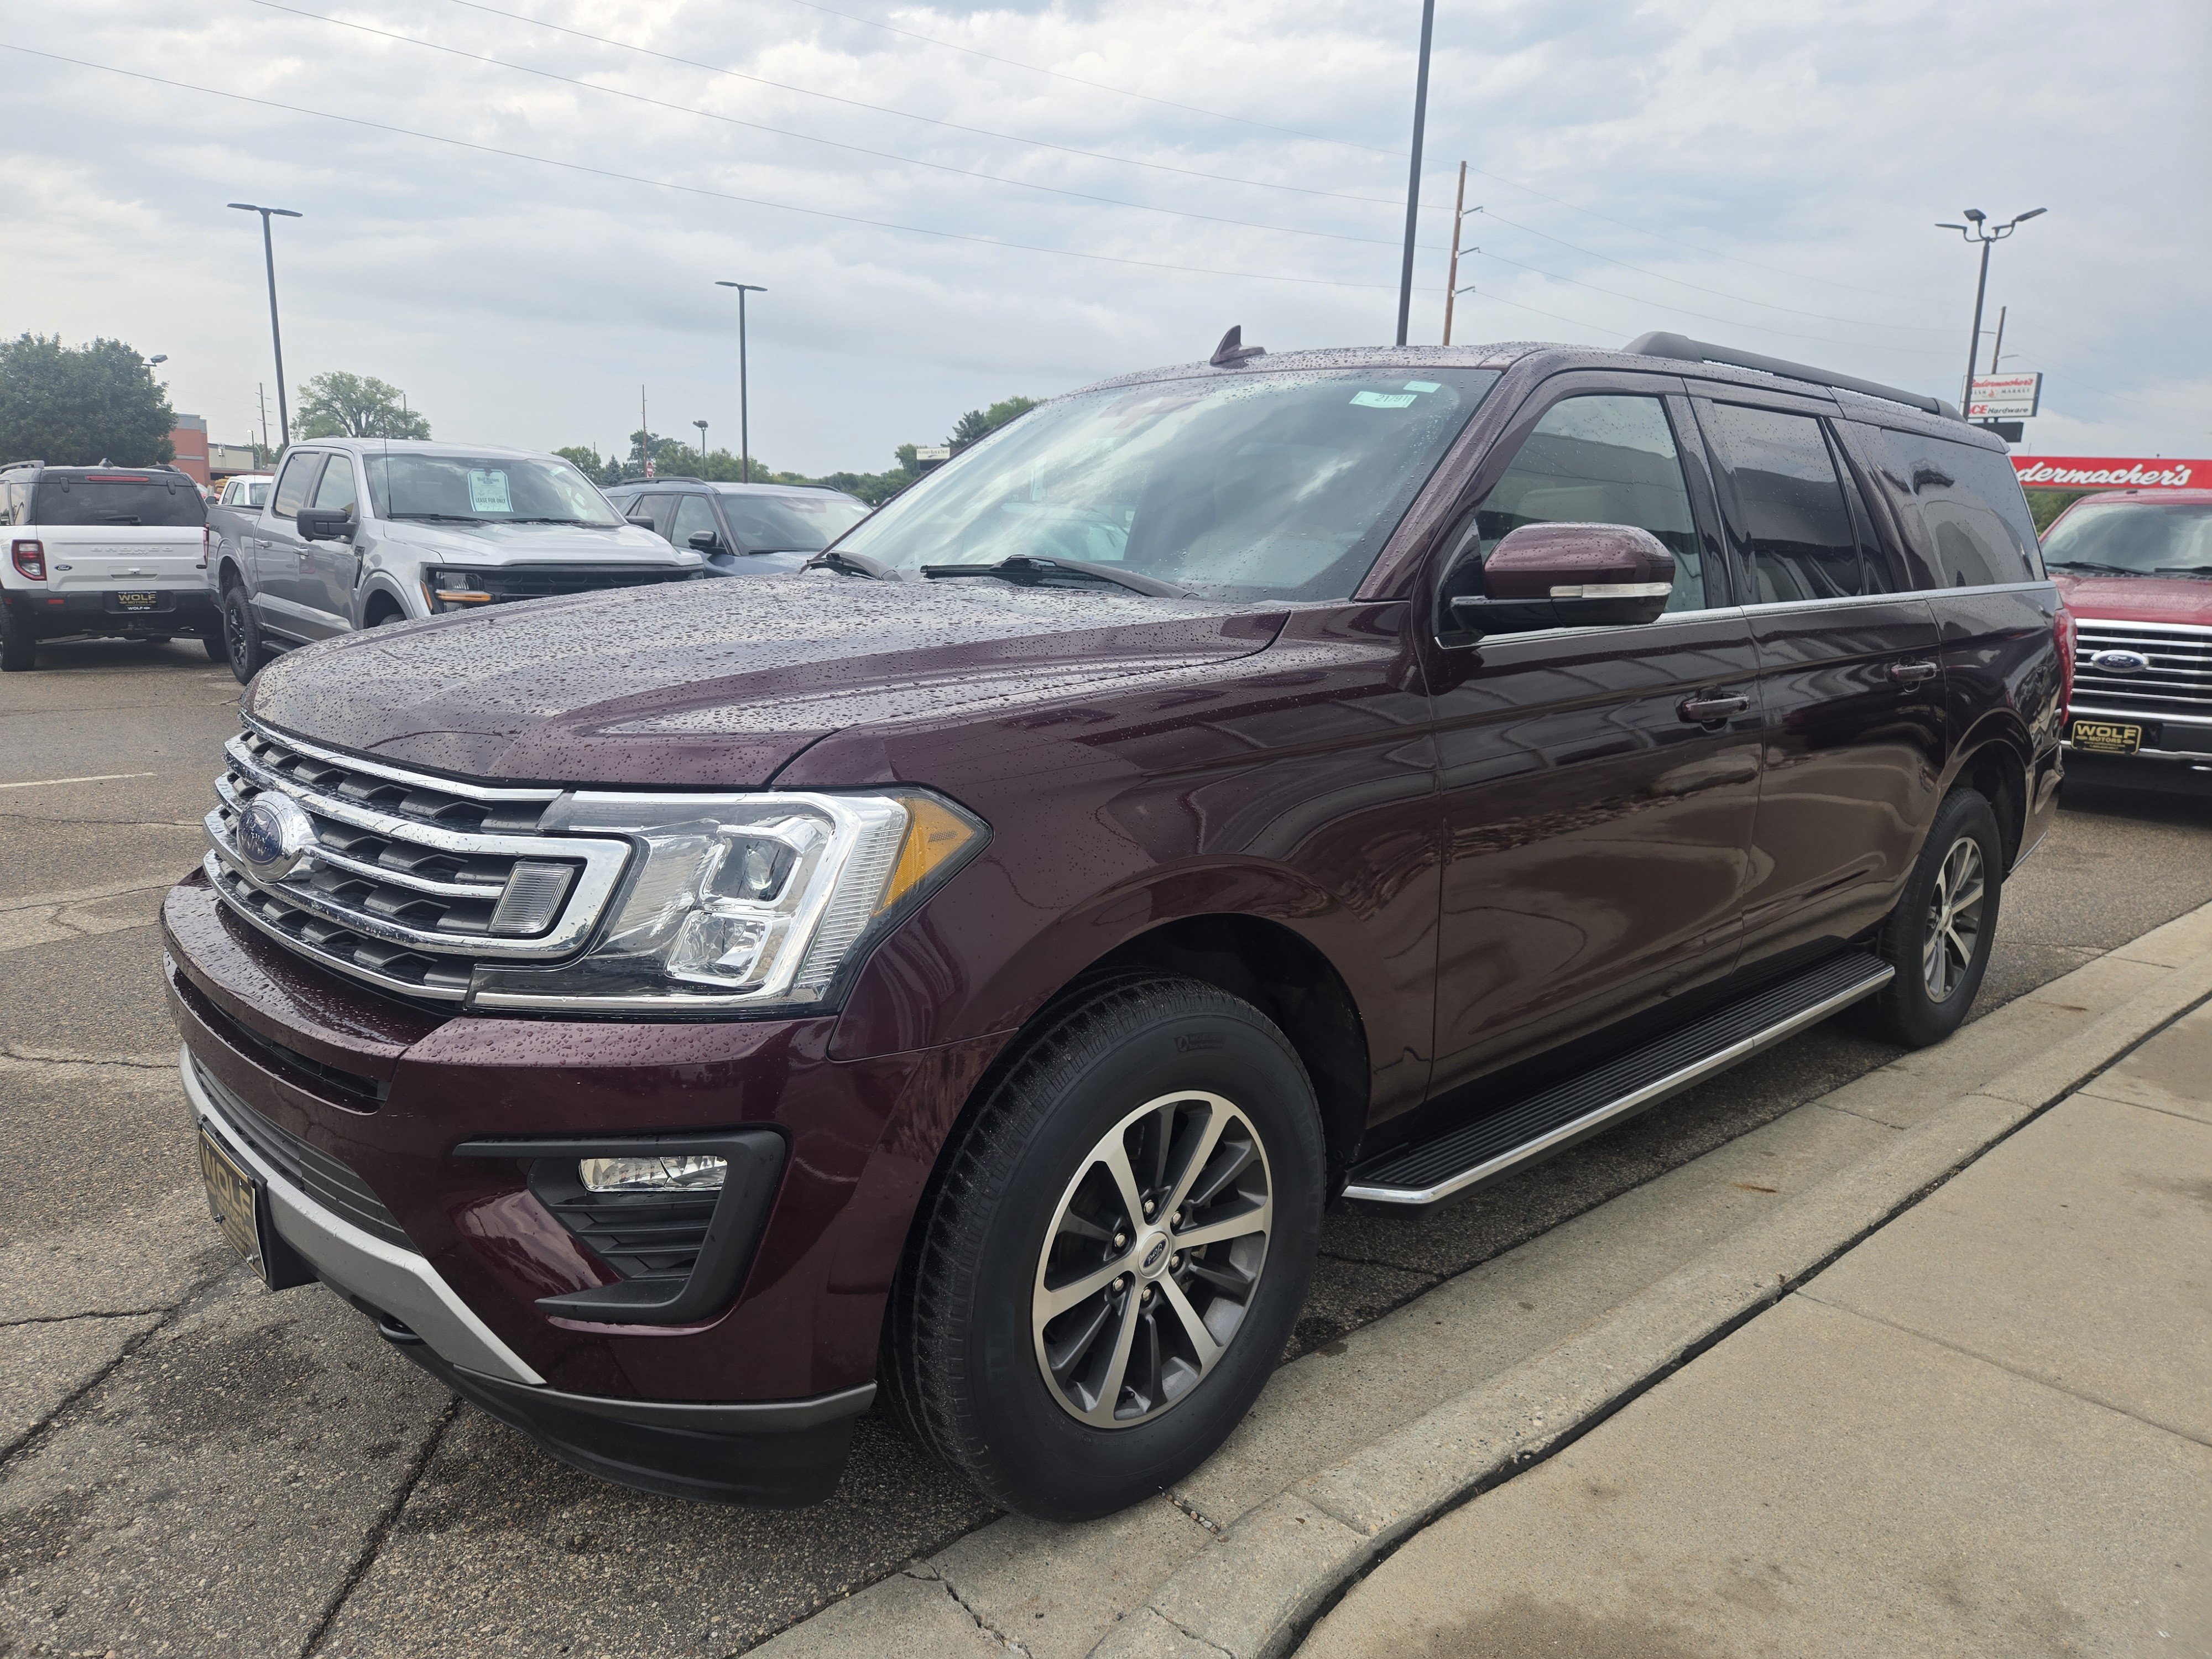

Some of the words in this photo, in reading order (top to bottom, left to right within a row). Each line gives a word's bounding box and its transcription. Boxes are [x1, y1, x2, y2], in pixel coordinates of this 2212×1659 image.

[1973, 378, 2034, 388] adermacher's
[1969, 405, 1988, 414] CE
[2016, 461, 2192, 486] dermacher's
[2077, 724, 2137, 739] WOLF
[200, 1141, 251, 1220] WOLF
[216, 1189, 245, 1232] MOTORS
